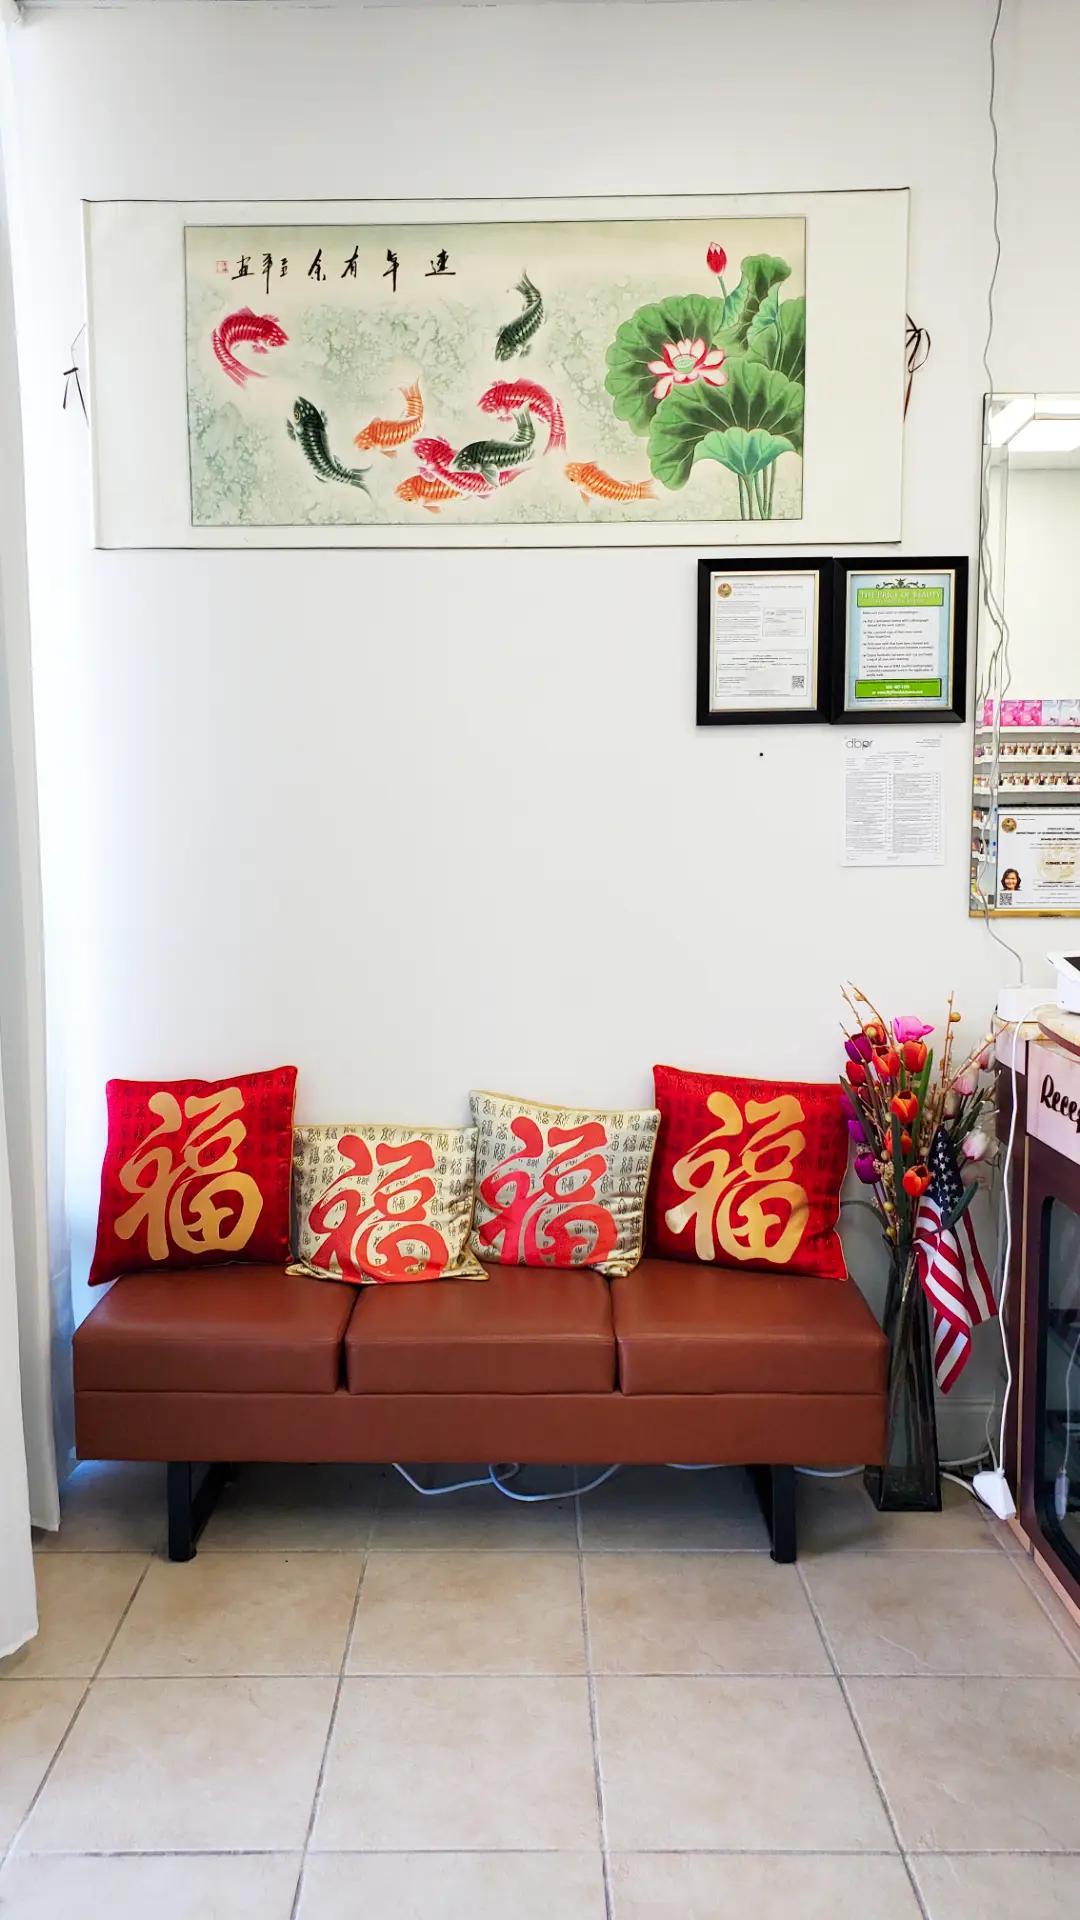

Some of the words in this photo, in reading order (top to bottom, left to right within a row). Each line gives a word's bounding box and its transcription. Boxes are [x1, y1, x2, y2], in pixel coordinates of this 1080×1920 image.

[845, 737, 874, 751] dbpr
[114, 1087, 263, 1261] 福
[309, 1134, 449, 1284] 福
[479, 1116, 617, 1269] 福
[665, 1091, 809, 1264] 福
